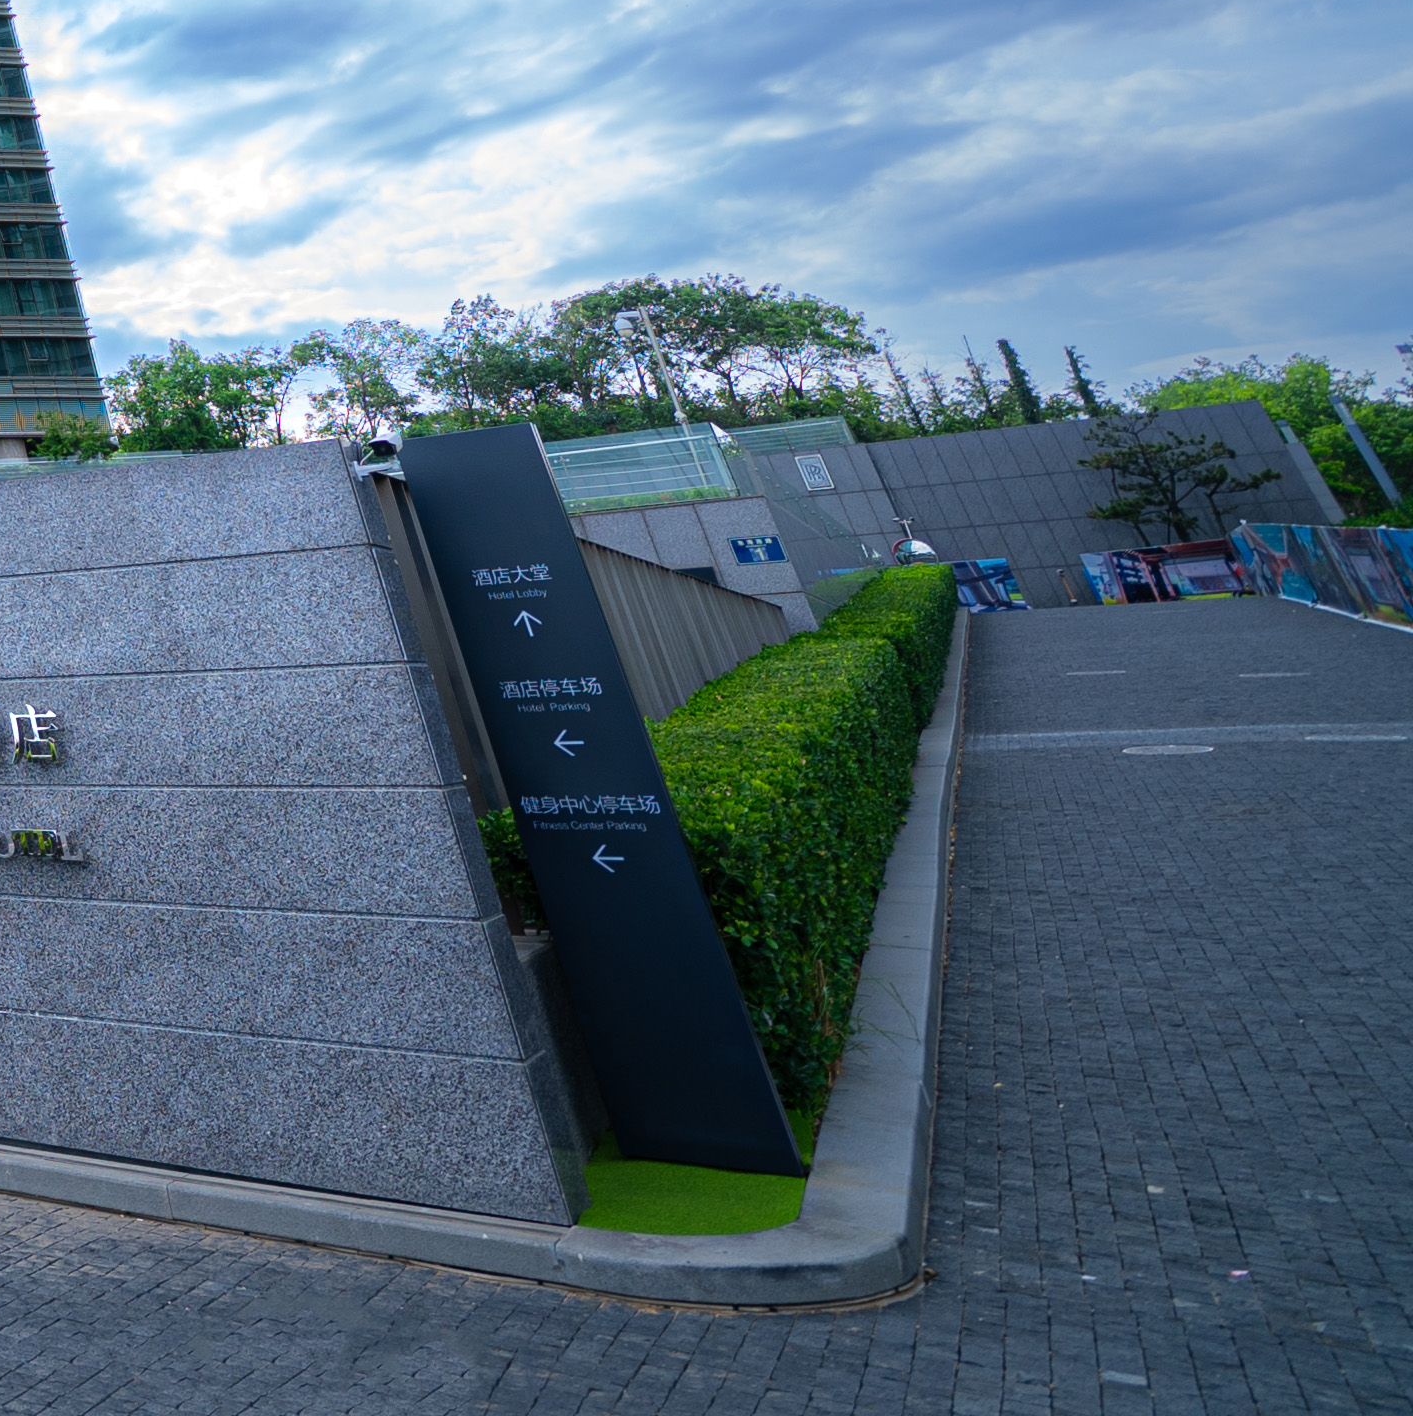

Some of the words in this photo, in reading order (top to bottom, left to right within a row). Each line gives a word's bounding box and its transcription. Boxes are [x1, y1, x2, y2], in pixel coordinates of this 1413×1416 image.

[471, 563, 553, 587] 酒店大堂
[487, 590, 515, 601] Hotel
[516, 588, 547, 599] Lobby
[498, 676, 603, 699] 酒店停车场
[517, 703, 545, 713] Hotel
[549, 702, 591, 713] Parking
[520, 794, 662, 815] 健身中心停车场
[533, 820, 570, 830] Fitness
[570, 820, 604, 830] Center
[605, 820, 648, 832] Parking
